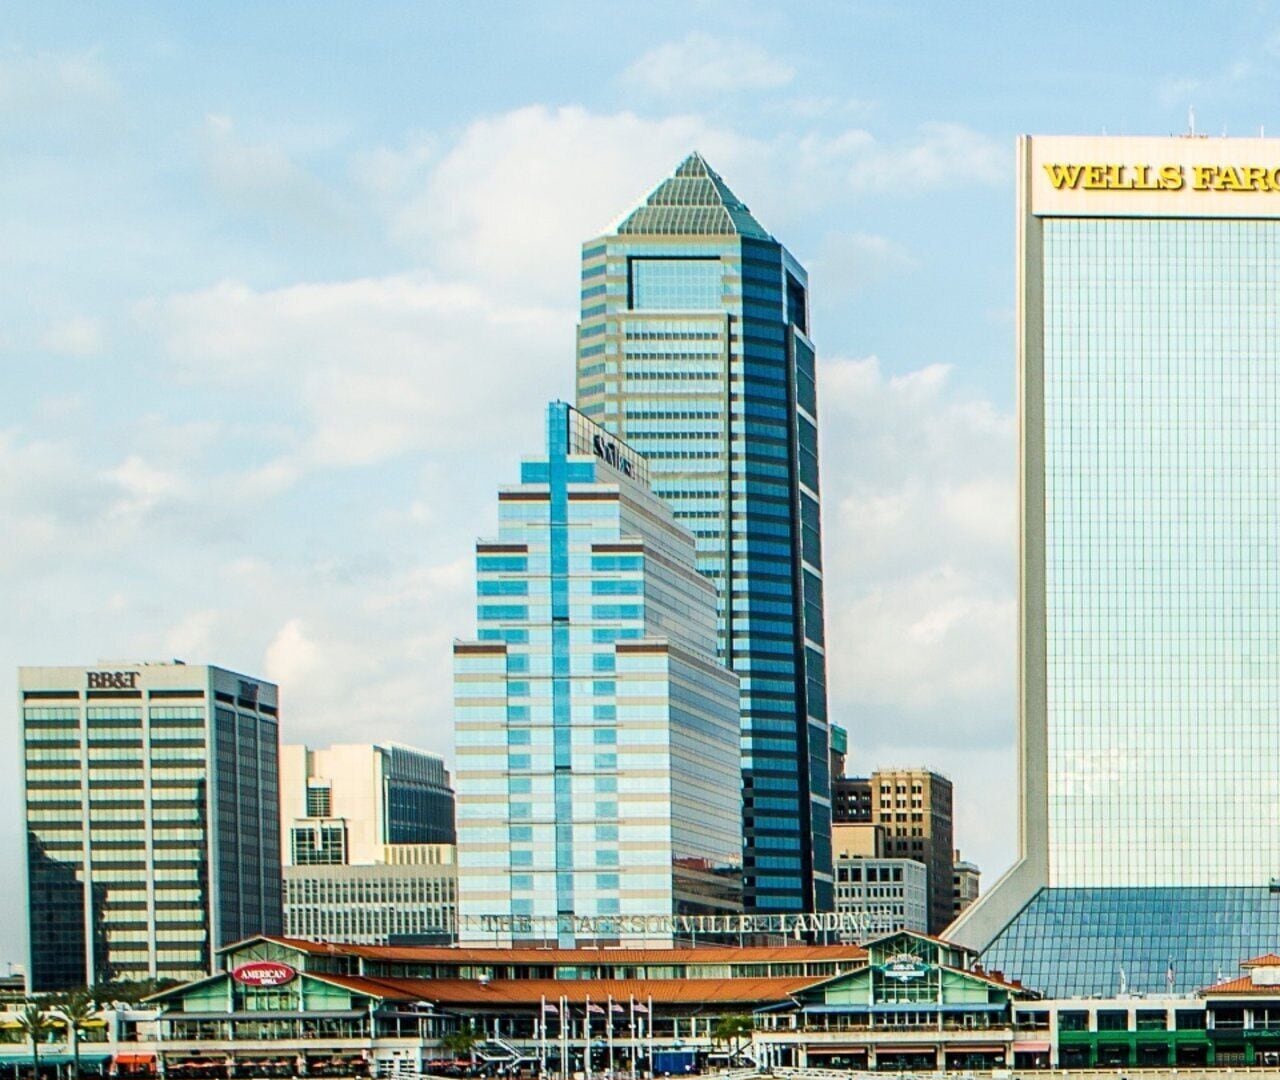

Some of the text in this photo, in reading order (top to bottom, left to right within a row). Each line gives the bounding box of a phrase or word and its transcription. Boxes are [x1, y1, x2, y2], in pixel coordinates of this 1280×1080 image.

[1043, 162, 1184, 190] WELLS
[87, 671, 140, 688] BB&T
[483, 911, 872, 933] THE JACKSONVILLE LANDING
[241, 969, 287, 980] AMERICAN
